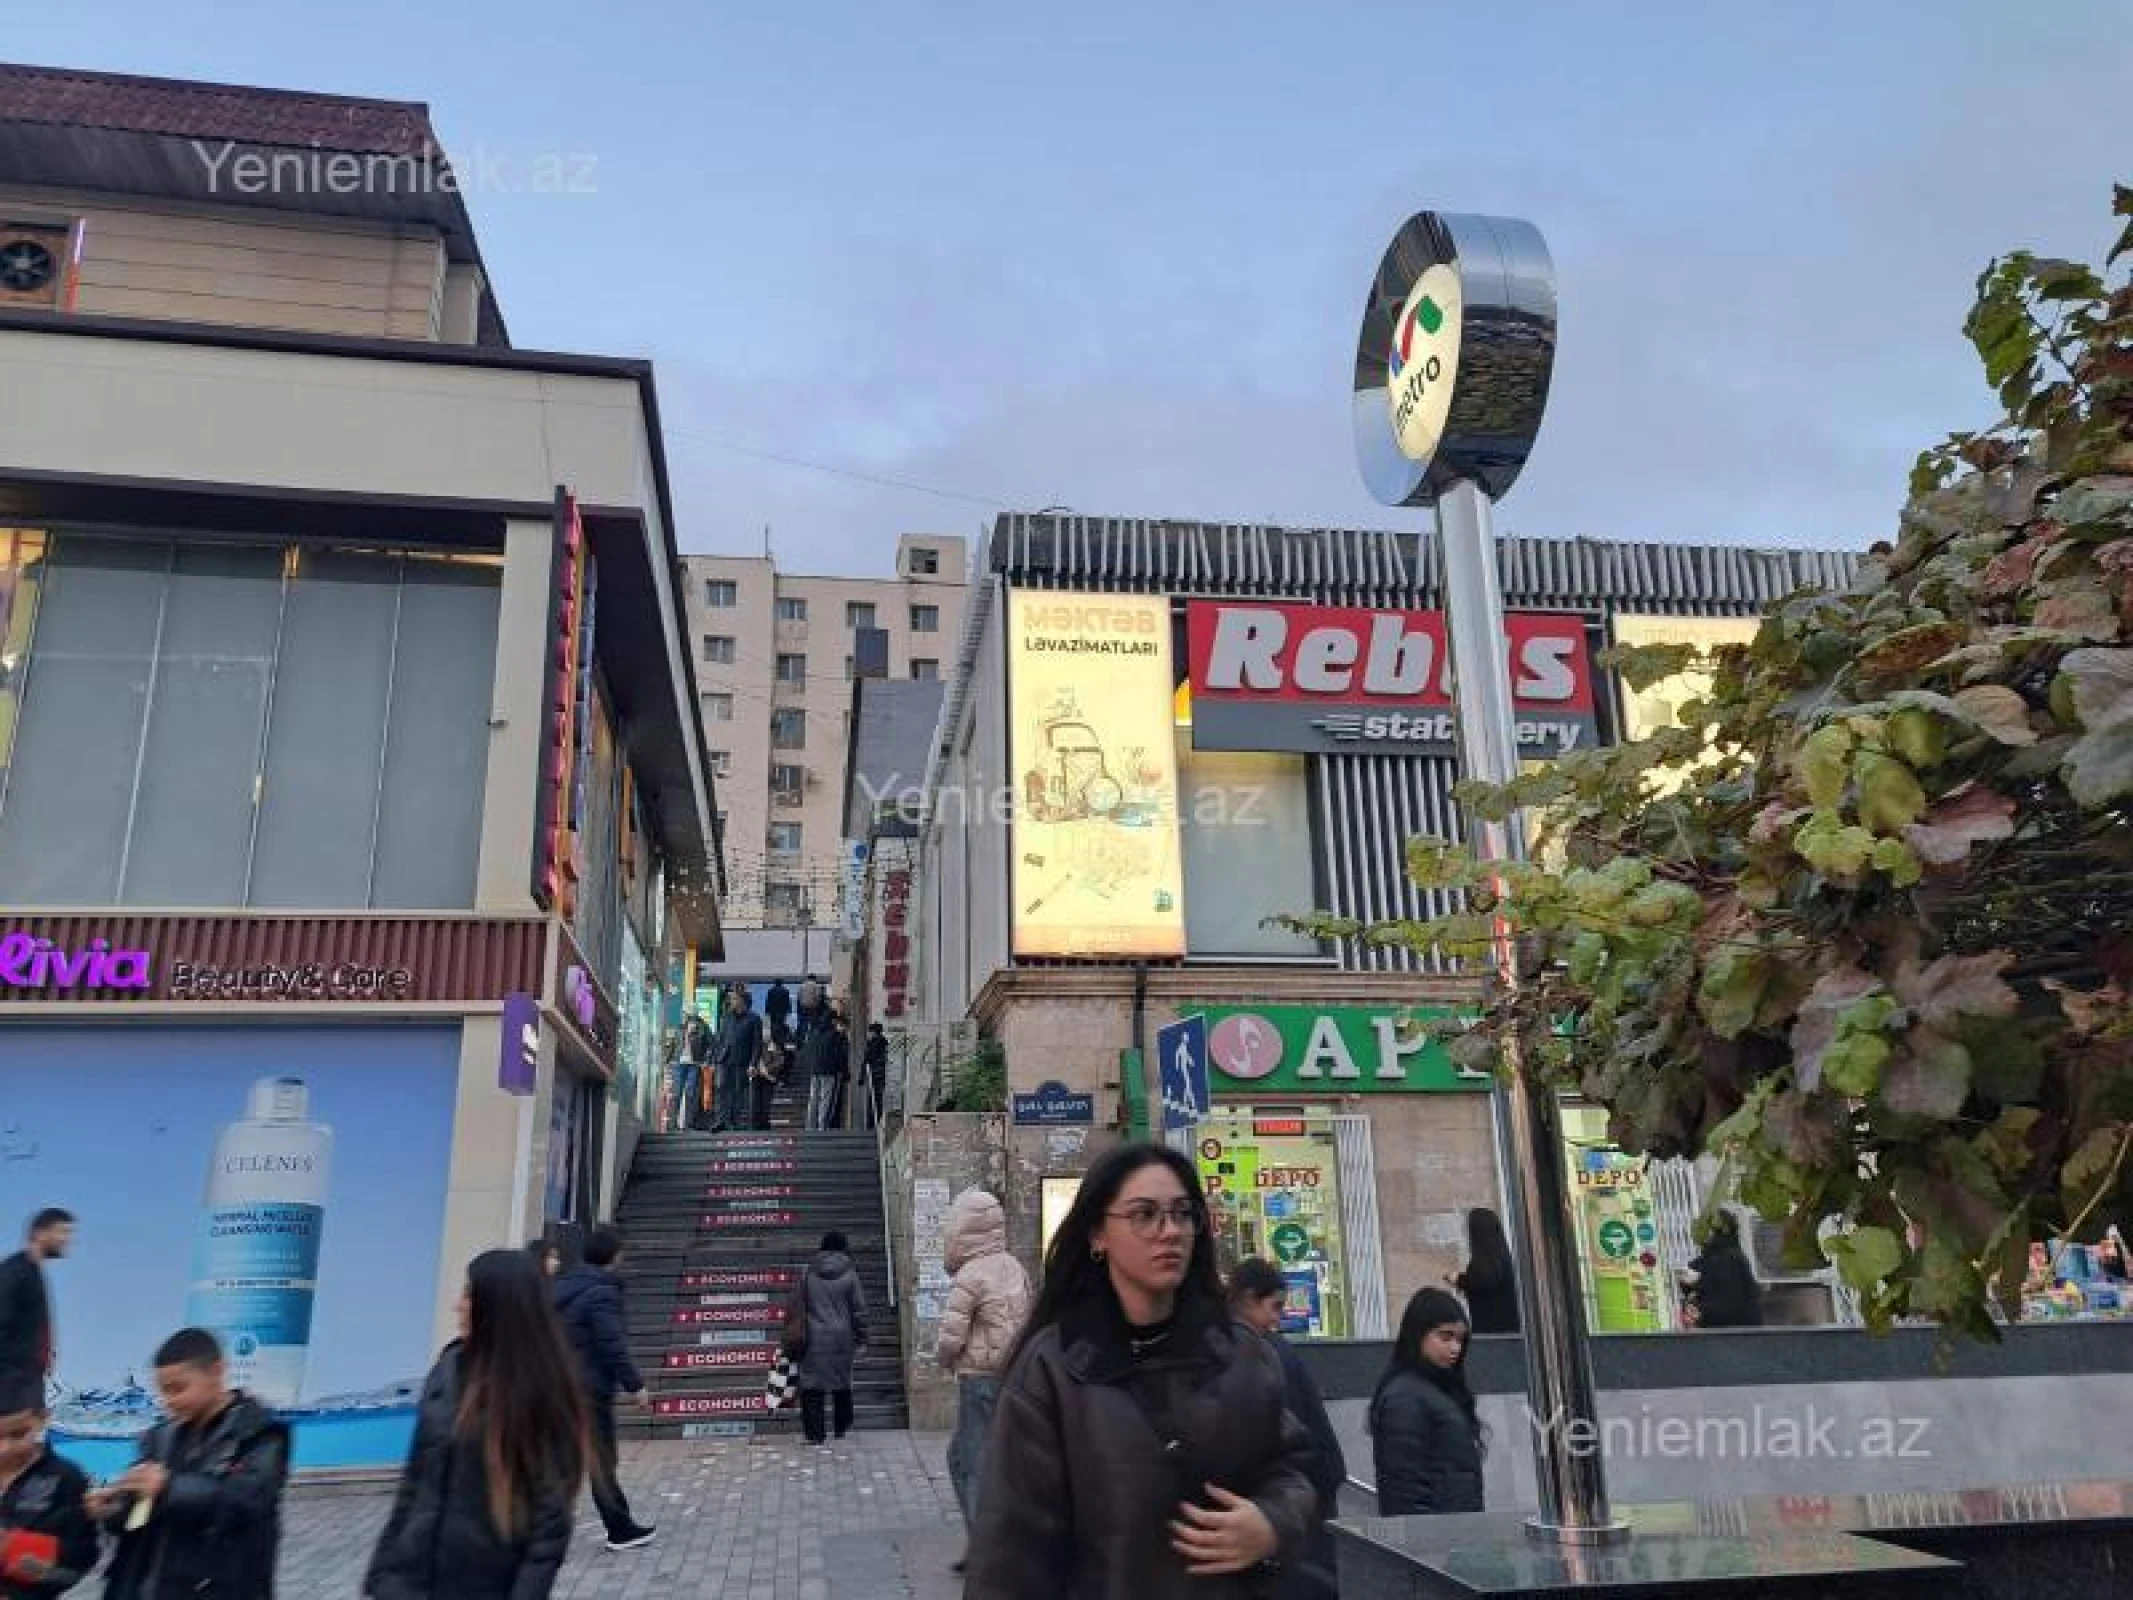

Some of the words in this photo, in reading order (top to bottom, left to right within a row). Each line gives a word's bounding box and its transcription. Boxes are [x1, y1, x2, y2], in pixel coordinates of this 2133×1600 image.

[1206, 606, 1576, 700] Rebs
[1363, 713, 1582, 751] statery
[687, 1351, 767, 1365] ECONOMIC
[679, 1396, 764, 1412] ECONOMIC
